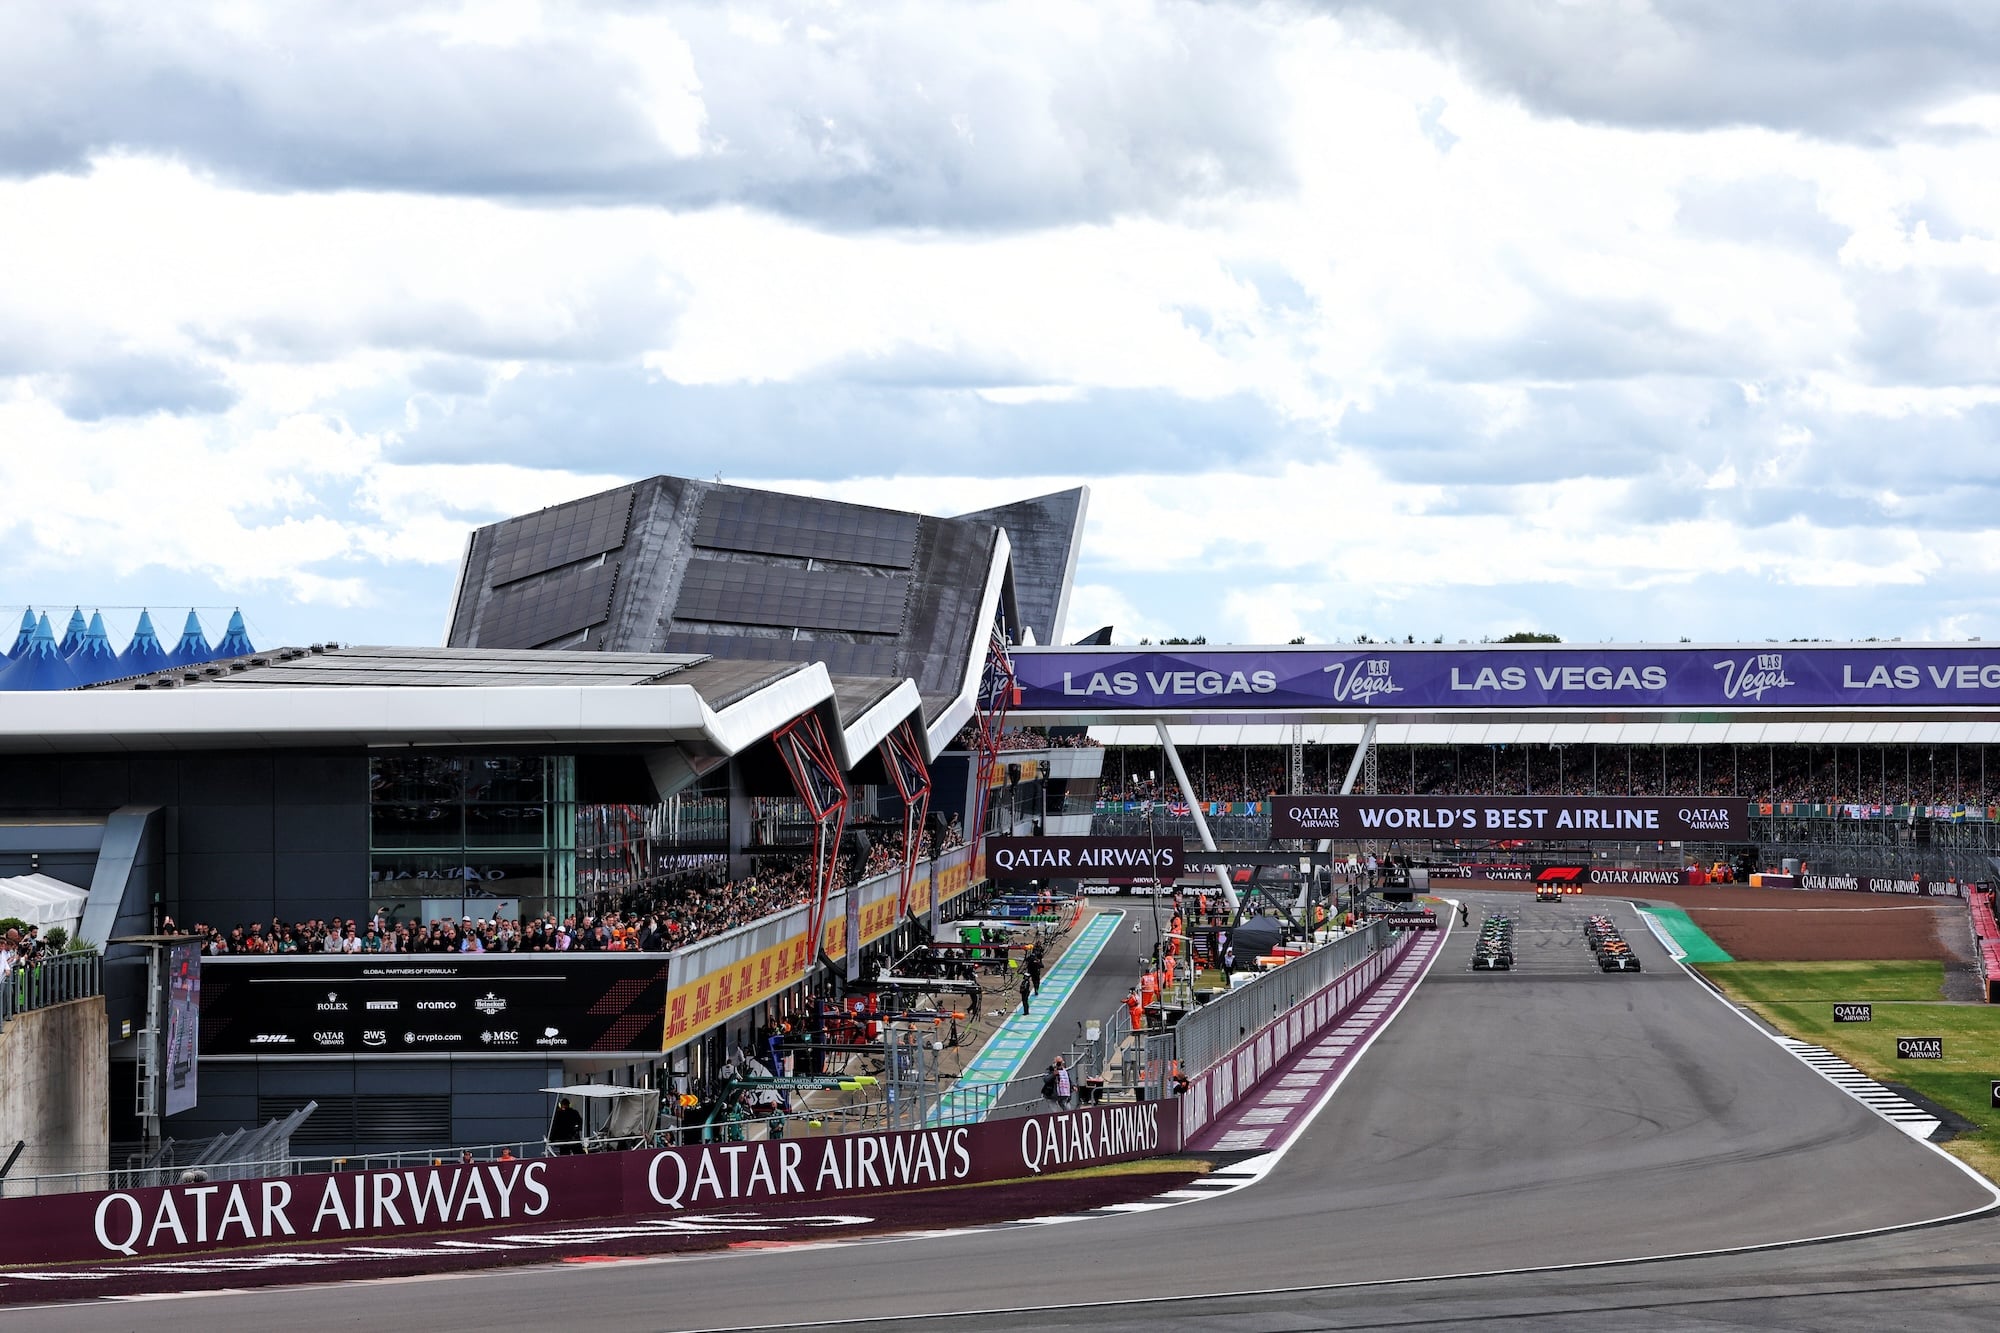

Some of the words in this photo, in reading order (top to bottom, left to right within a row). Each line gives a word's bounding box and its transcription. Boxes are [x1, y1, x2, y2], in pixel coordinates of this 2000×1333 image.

[1368, 661, 1388, 675] LAS
[1760, 656, 1780, 670] LAS
[1064, 671, 1138, 696] LAS
[1145, 670, 1277, 696] VEGAS
[1324, 660, 1403, 704] Vegas
[1451, 667, 1527, 691] LAS
[1534, 666, 1668, 691] VEGAS
[1713, 656, 1795, 701] Vegas
[1843, 665, 1920, 689] LAS
[1927, 665, 2000, 689] VEG
[1289, 807, 1338, 822] QATAR
[1359, 808, 1476, 829] WORLD'S
[1486, 808, 1548, 829] BEST
[1556, 808, 1660, 830] AIRLINE
[1678, 808, 1729, 824] QATAR
[1300, 819, 1340, 828] AIRWAYS
[1690, 819, 1730, 830] AIRWAYS
[995, 849, 1072, 870] QATAR
[1077, 848, 1174, 867] AIRWAYS
[1590, 870, 1629, 883] QATAR
[1631, 871, 1679, 884] AIRWAYS
[1802, 875, 1826, 889] QATAR
[1827, 877, 1858, 890] AIRWAYS
[1869, 878, 1892, 892] QATAR
[1893, 880, 1920, 894] AIRWAYS
[1928, 882, 1945, 896] QATAR
[417, 1001, 457, 1009] aramco
[1835, 1006, 1870, 1017] QATAR
[255, 1034, 290, 1043] DHL
[313, 1032, 344, 1041] QATAR
[363, 1030, 386, 1040] aws
[417, 1033, 462, 1042] crypto.com
[493, 1031, 519, 1041] MSC
[536, 1037, 568, 1046] salesforce
[1898, 1041, 1940, 1053] QATAR
[1020, 1110, 1096, 1173] QATAR
[1098, 1103, 1159, 1157] AIRWAYS
[647, 1141, 803, 1209] QATAR
[815, 1127, 971, 1191] AIRWAYS
[94, 1181, 297, 1256] QATAR
[312, 1161, 550, 1232] AIRWAYS
